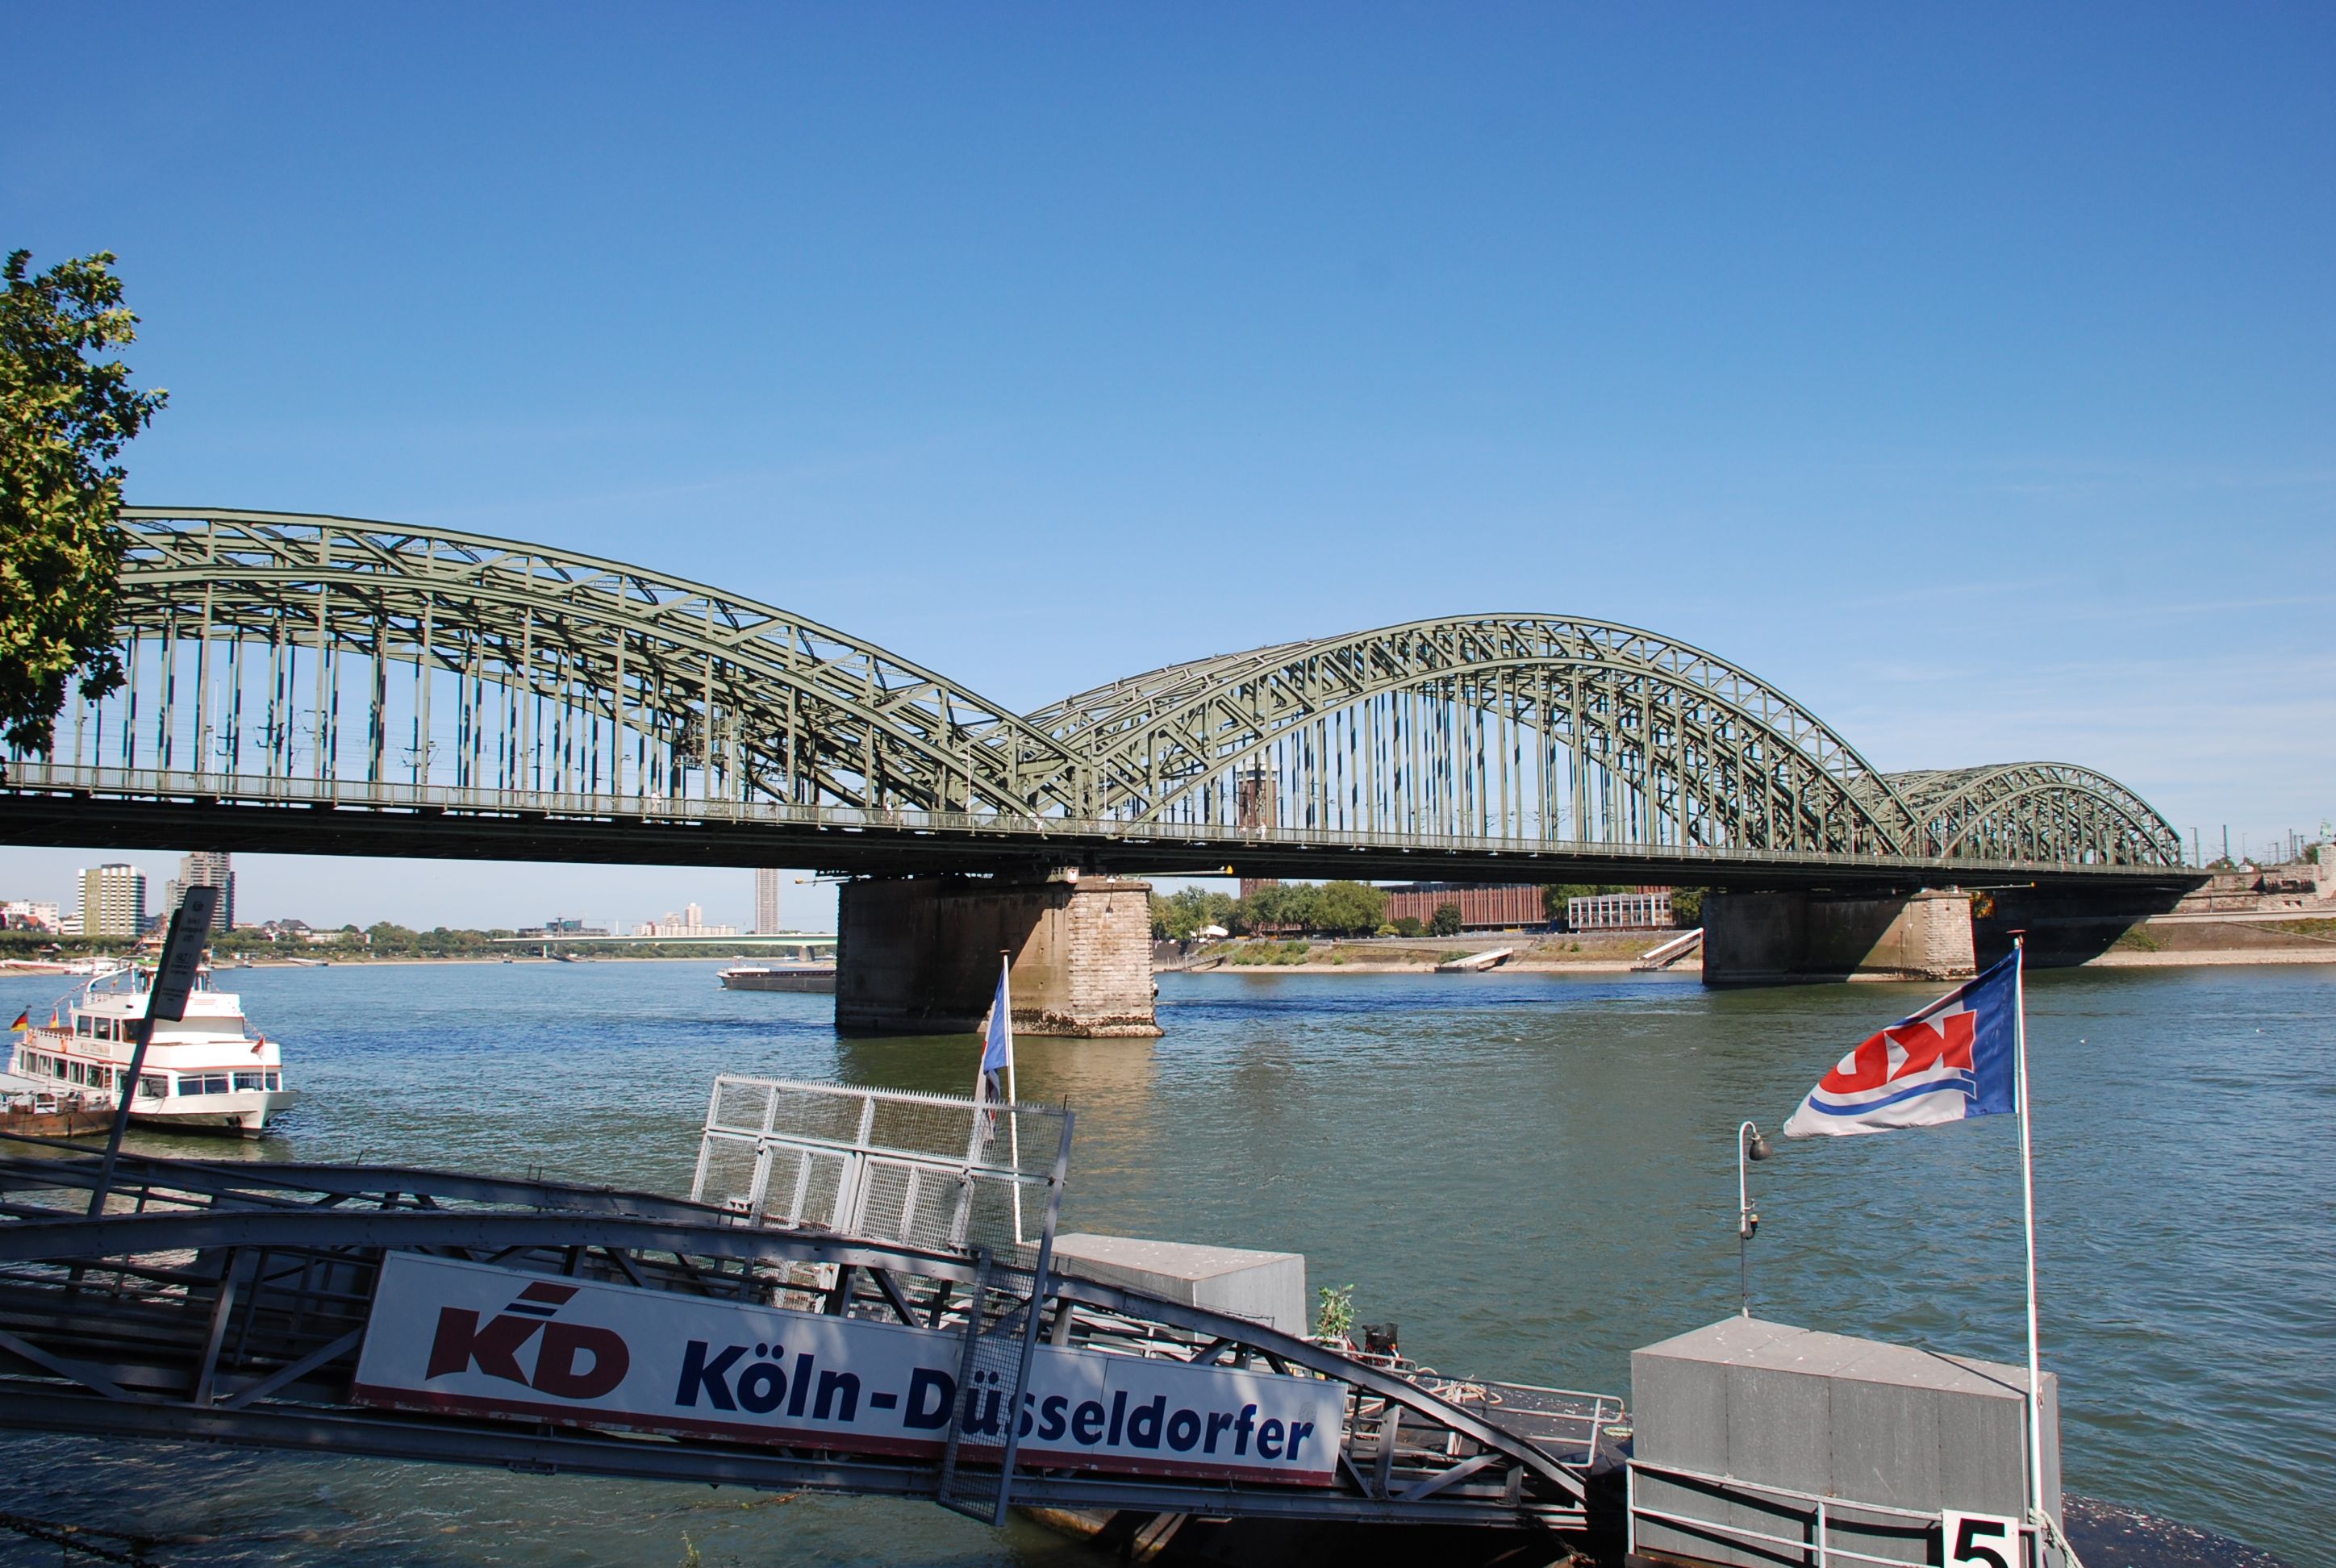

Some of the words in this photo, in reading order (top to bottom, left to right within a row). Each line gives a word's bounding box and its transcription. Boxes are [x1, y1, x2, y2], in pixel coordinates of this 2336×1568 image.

[425, 1306, 630, 1399] KD
[674, 1340, 1315, 1462] Köln-Düsseldorfer
[1954, 1517, 2009, 1568] 5
